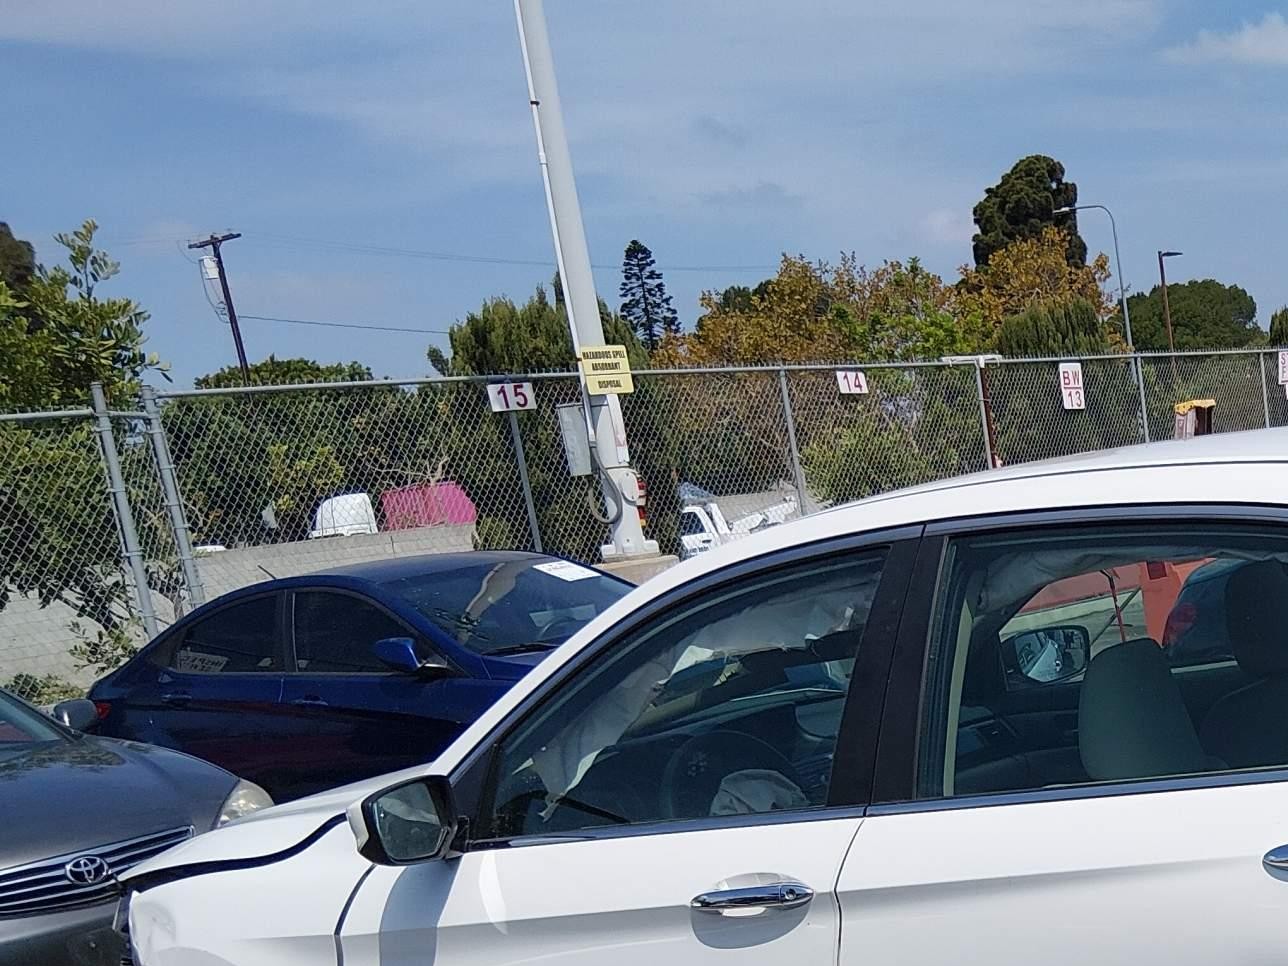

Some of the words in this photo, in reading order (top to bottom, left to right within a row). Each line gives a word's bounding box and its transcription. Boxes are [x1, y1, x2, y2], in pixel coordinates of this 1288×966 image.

[843, 373, 863, 392] 14
[1062, 370, 1080, 386] BW
[497, 384, 529, 409] 15
[1067, 390, 1082, 408] 13
